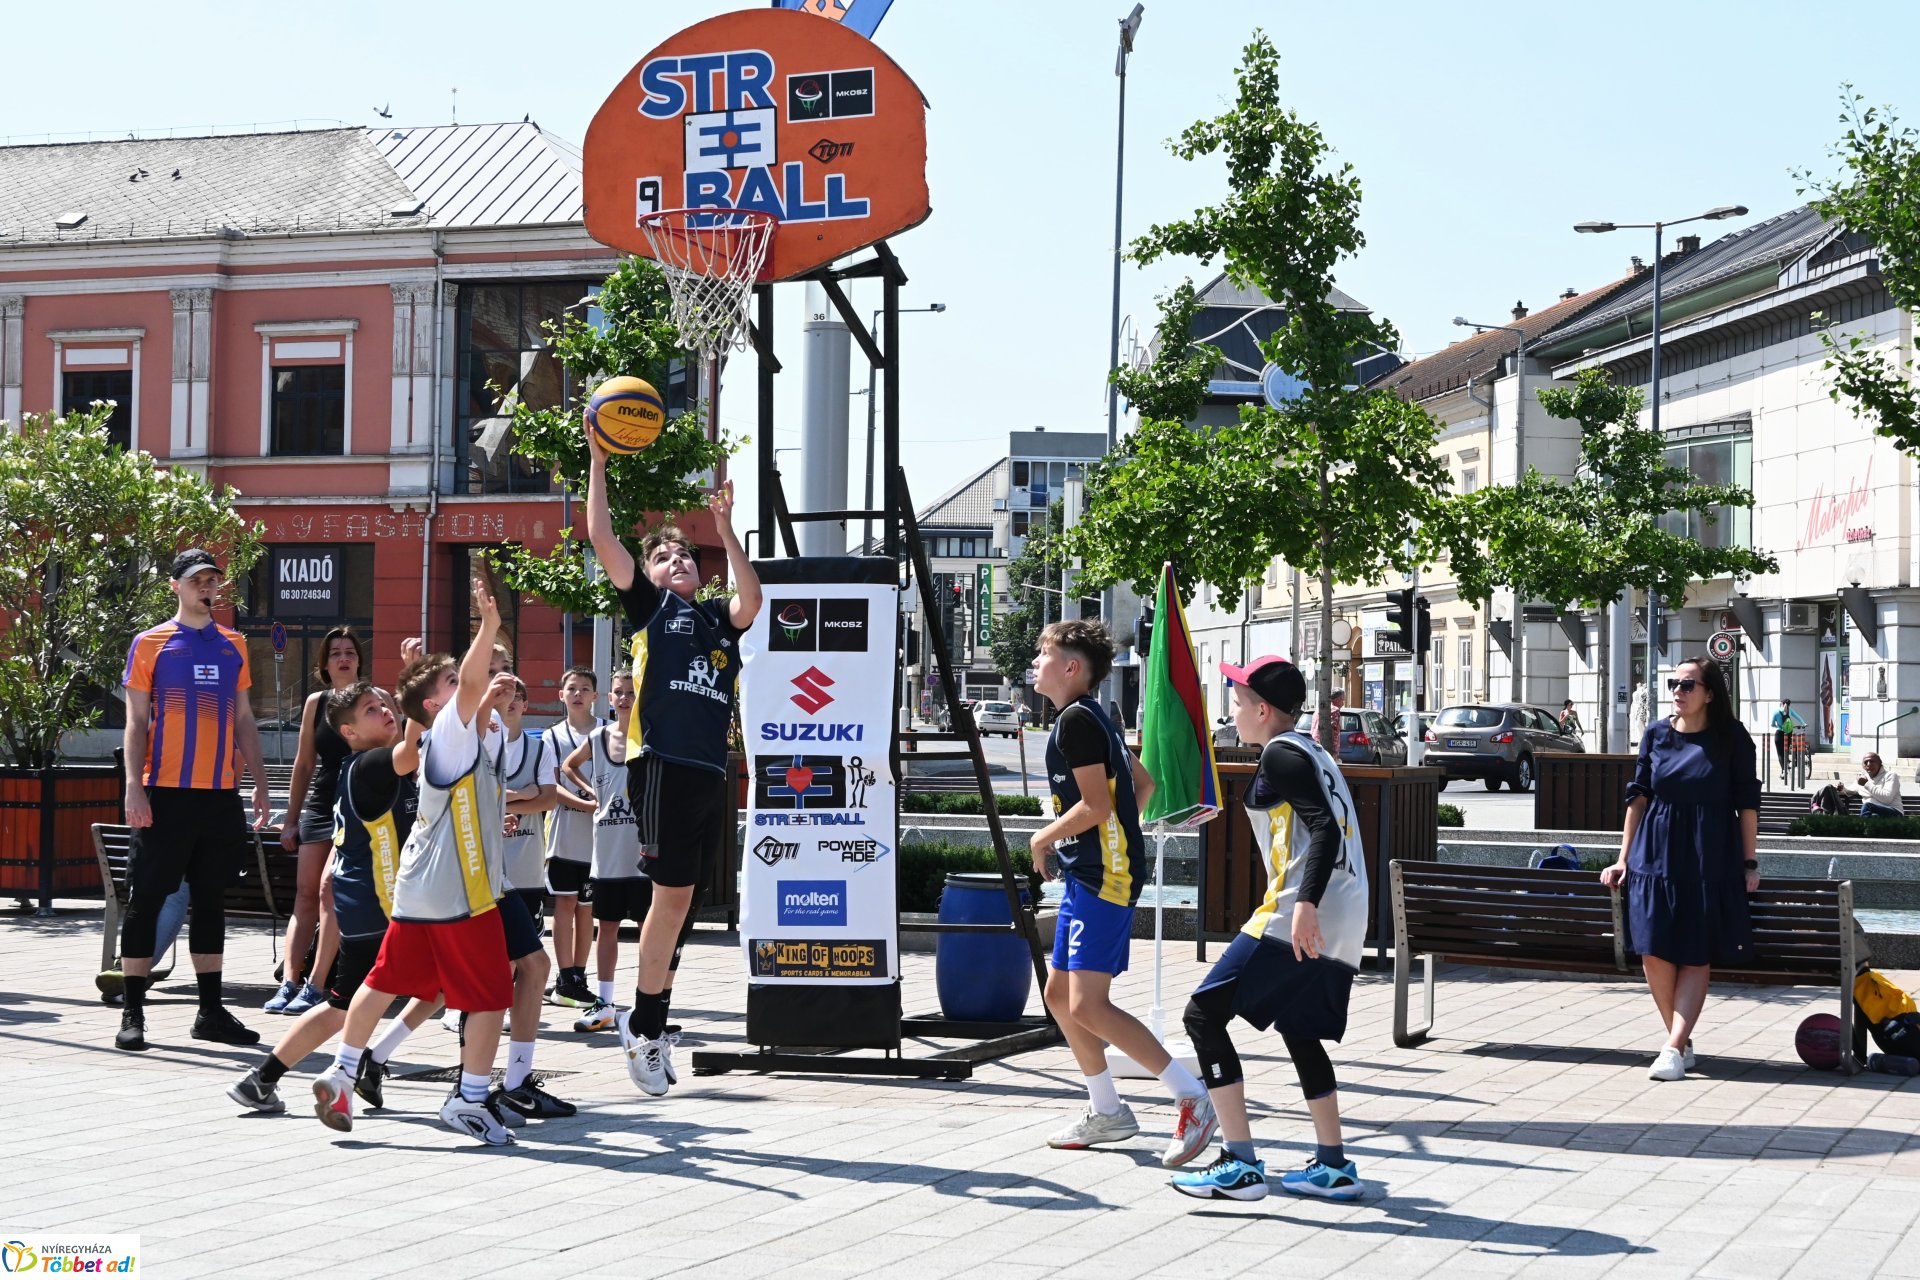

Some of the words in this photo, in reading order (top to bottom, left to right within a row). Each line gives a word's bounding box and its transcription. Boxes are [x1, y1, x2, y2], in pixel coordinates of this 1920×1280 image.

[637, 49, 778, 120] STR
[835, 88, 869, 98] MKOSZ
[819, 142, 855, 158] TOTI
[683, 161, 870, 229] BALL
[812, 313, 825, 321] 36
[618, 405, 659, 422] molten
[280, 555, 332, 583] KIADÓ
[980, 568, 990, 642] PALEO
[761, 722, 864, 742] SUZUKI
[763, 842, 801, 860] TOTI
[818, 841, 877, 851] POWER
[842, 852, 876, 862] ADE
[785, 892, 839, 906] molten
[783, 907, 794, 915] For
[777, 943, 807, 962] KING
[812, 948, 828, 962] OF
[833, 949, 874, 963] HOOPS
